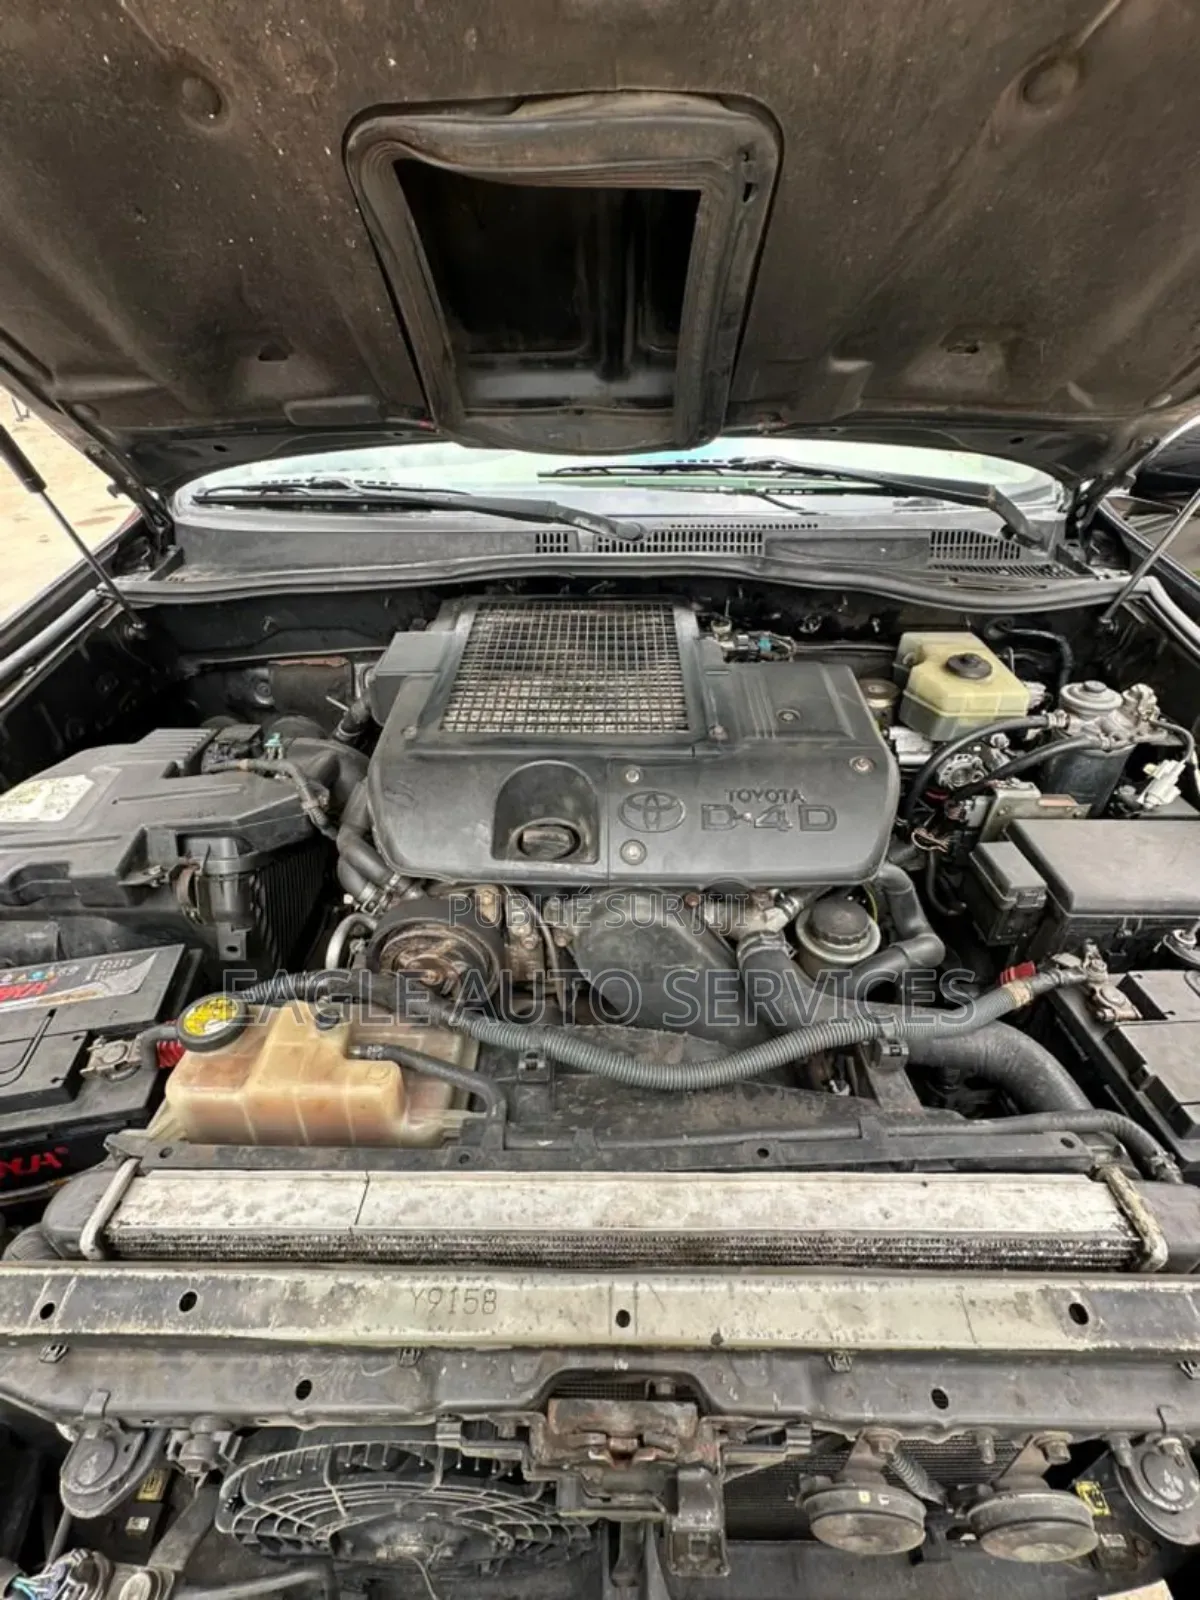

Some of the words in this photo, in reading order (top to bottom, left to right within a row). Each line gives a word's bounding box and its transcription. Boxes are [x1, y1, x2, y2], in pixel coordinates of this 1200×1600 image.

[725, 788, 806, 804] TOYOTA
[701, 803, 838, 832] D-4D
[410, 1286, 498, 1316] Y9158
